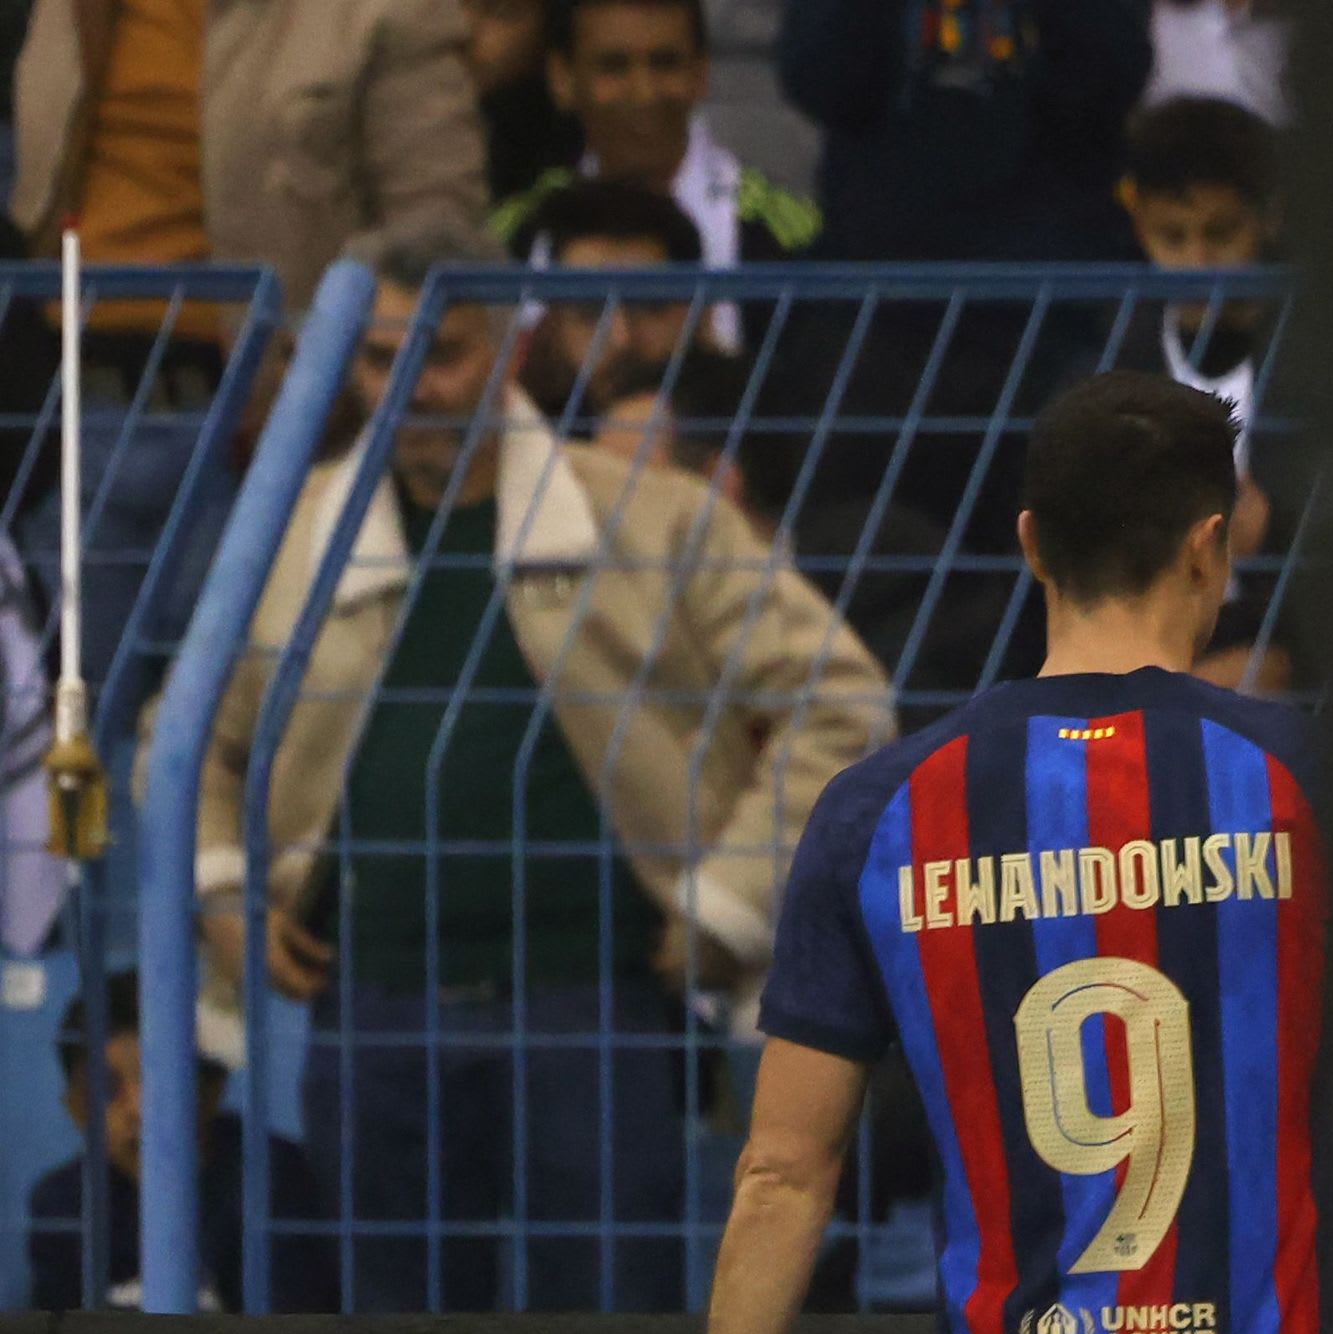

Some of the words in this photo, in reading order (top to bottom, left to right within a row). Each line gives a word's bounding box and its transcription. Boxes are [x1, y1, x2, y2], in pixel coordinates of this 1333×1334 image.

[899, 831, 1293, 933] LEWANDOWSKI
[1013, 956, 1196, 1275] 9
[1101, 1302, 1217, 1331] UNHCR
